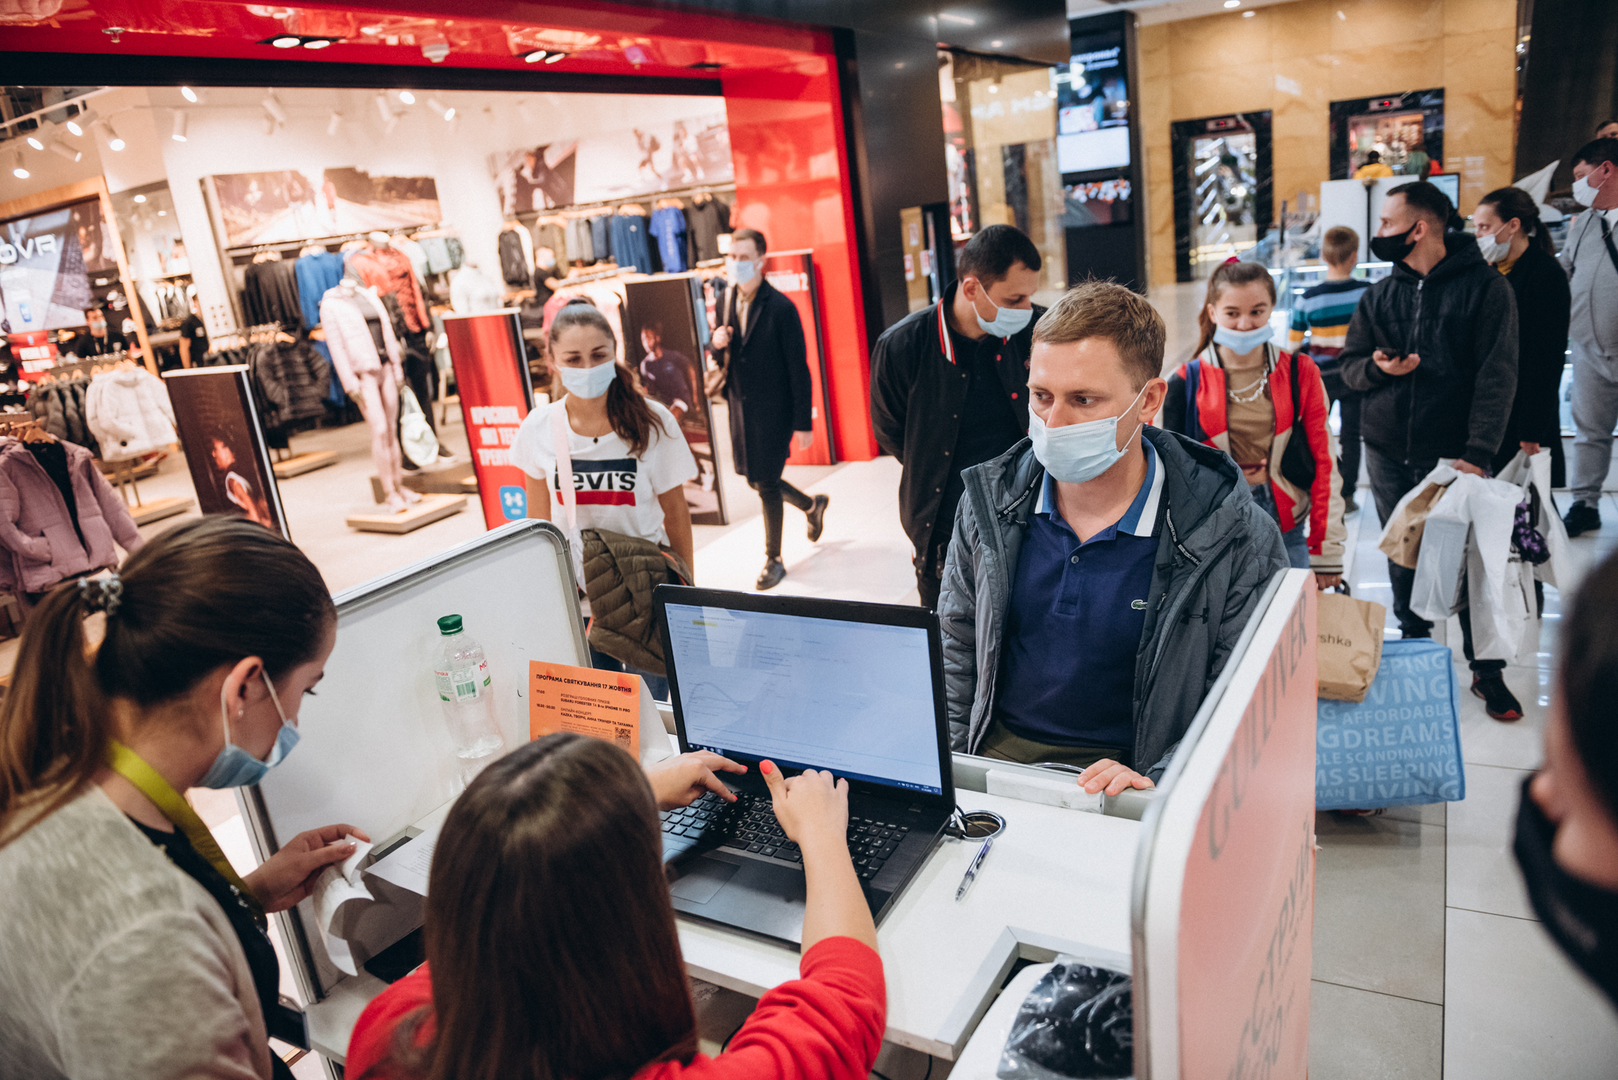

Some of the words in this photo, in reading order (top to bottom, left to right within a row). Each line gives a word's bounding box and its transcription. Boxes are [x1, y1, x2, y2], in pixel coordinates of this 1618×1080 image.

[536, 674, 563, 683] ПРОГРАМА
[563, 678, 602, 690] СВЯТКУВАННЯ
[609, 685, 632, 693] ЖОВТНЯ
[1342, 702, 1453, 726] AFFORDABLE
[1343, 719, 1455, 750] DREAMS
[1346, 744, 1457, 765] SCANDINAVIAN
[1348, 758, 1458, 784] SLEEPING
[1349, 779, 1461, 801] LIVING
